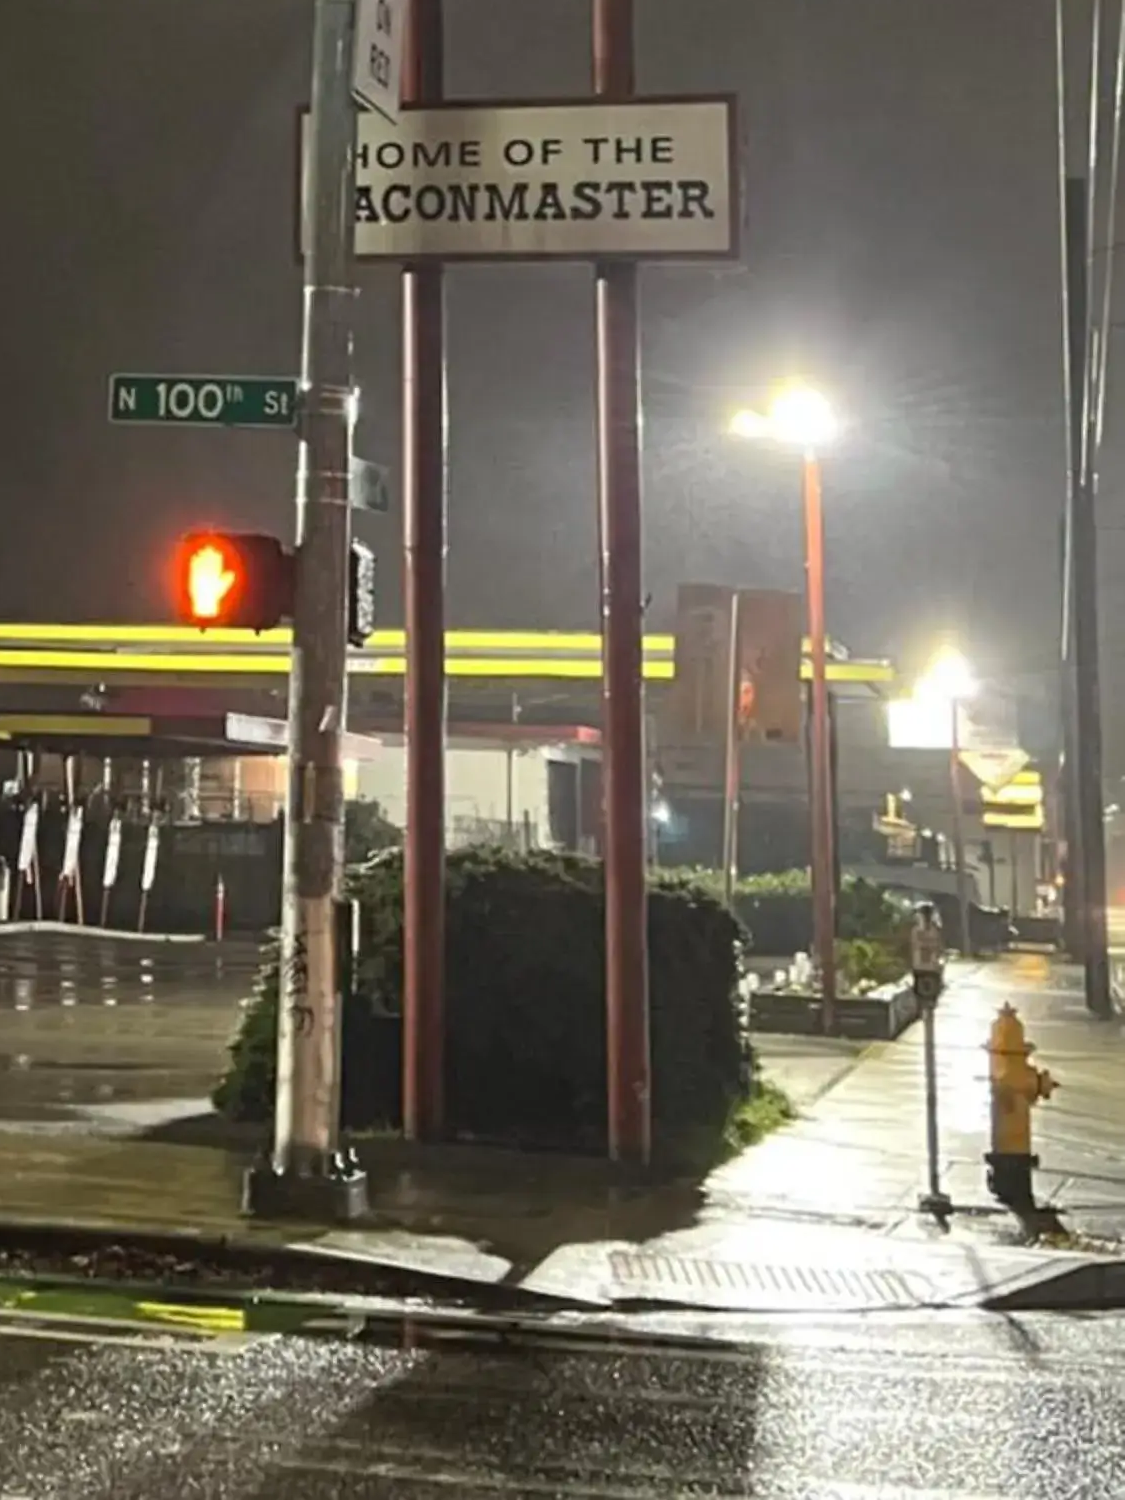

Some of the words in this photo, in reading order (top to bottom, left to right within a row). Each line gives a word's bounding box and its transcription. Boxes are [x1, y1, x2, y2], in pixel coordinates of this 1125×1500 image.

[369, 43, 391, 89] RED
[504, 139, 562, 166] OF
[583, 136, 674, 163] THE
[356, 180, 715, 223] ACONMASTER
[119, 386, 136, 411] N
[263, 390, 289, 415] St
